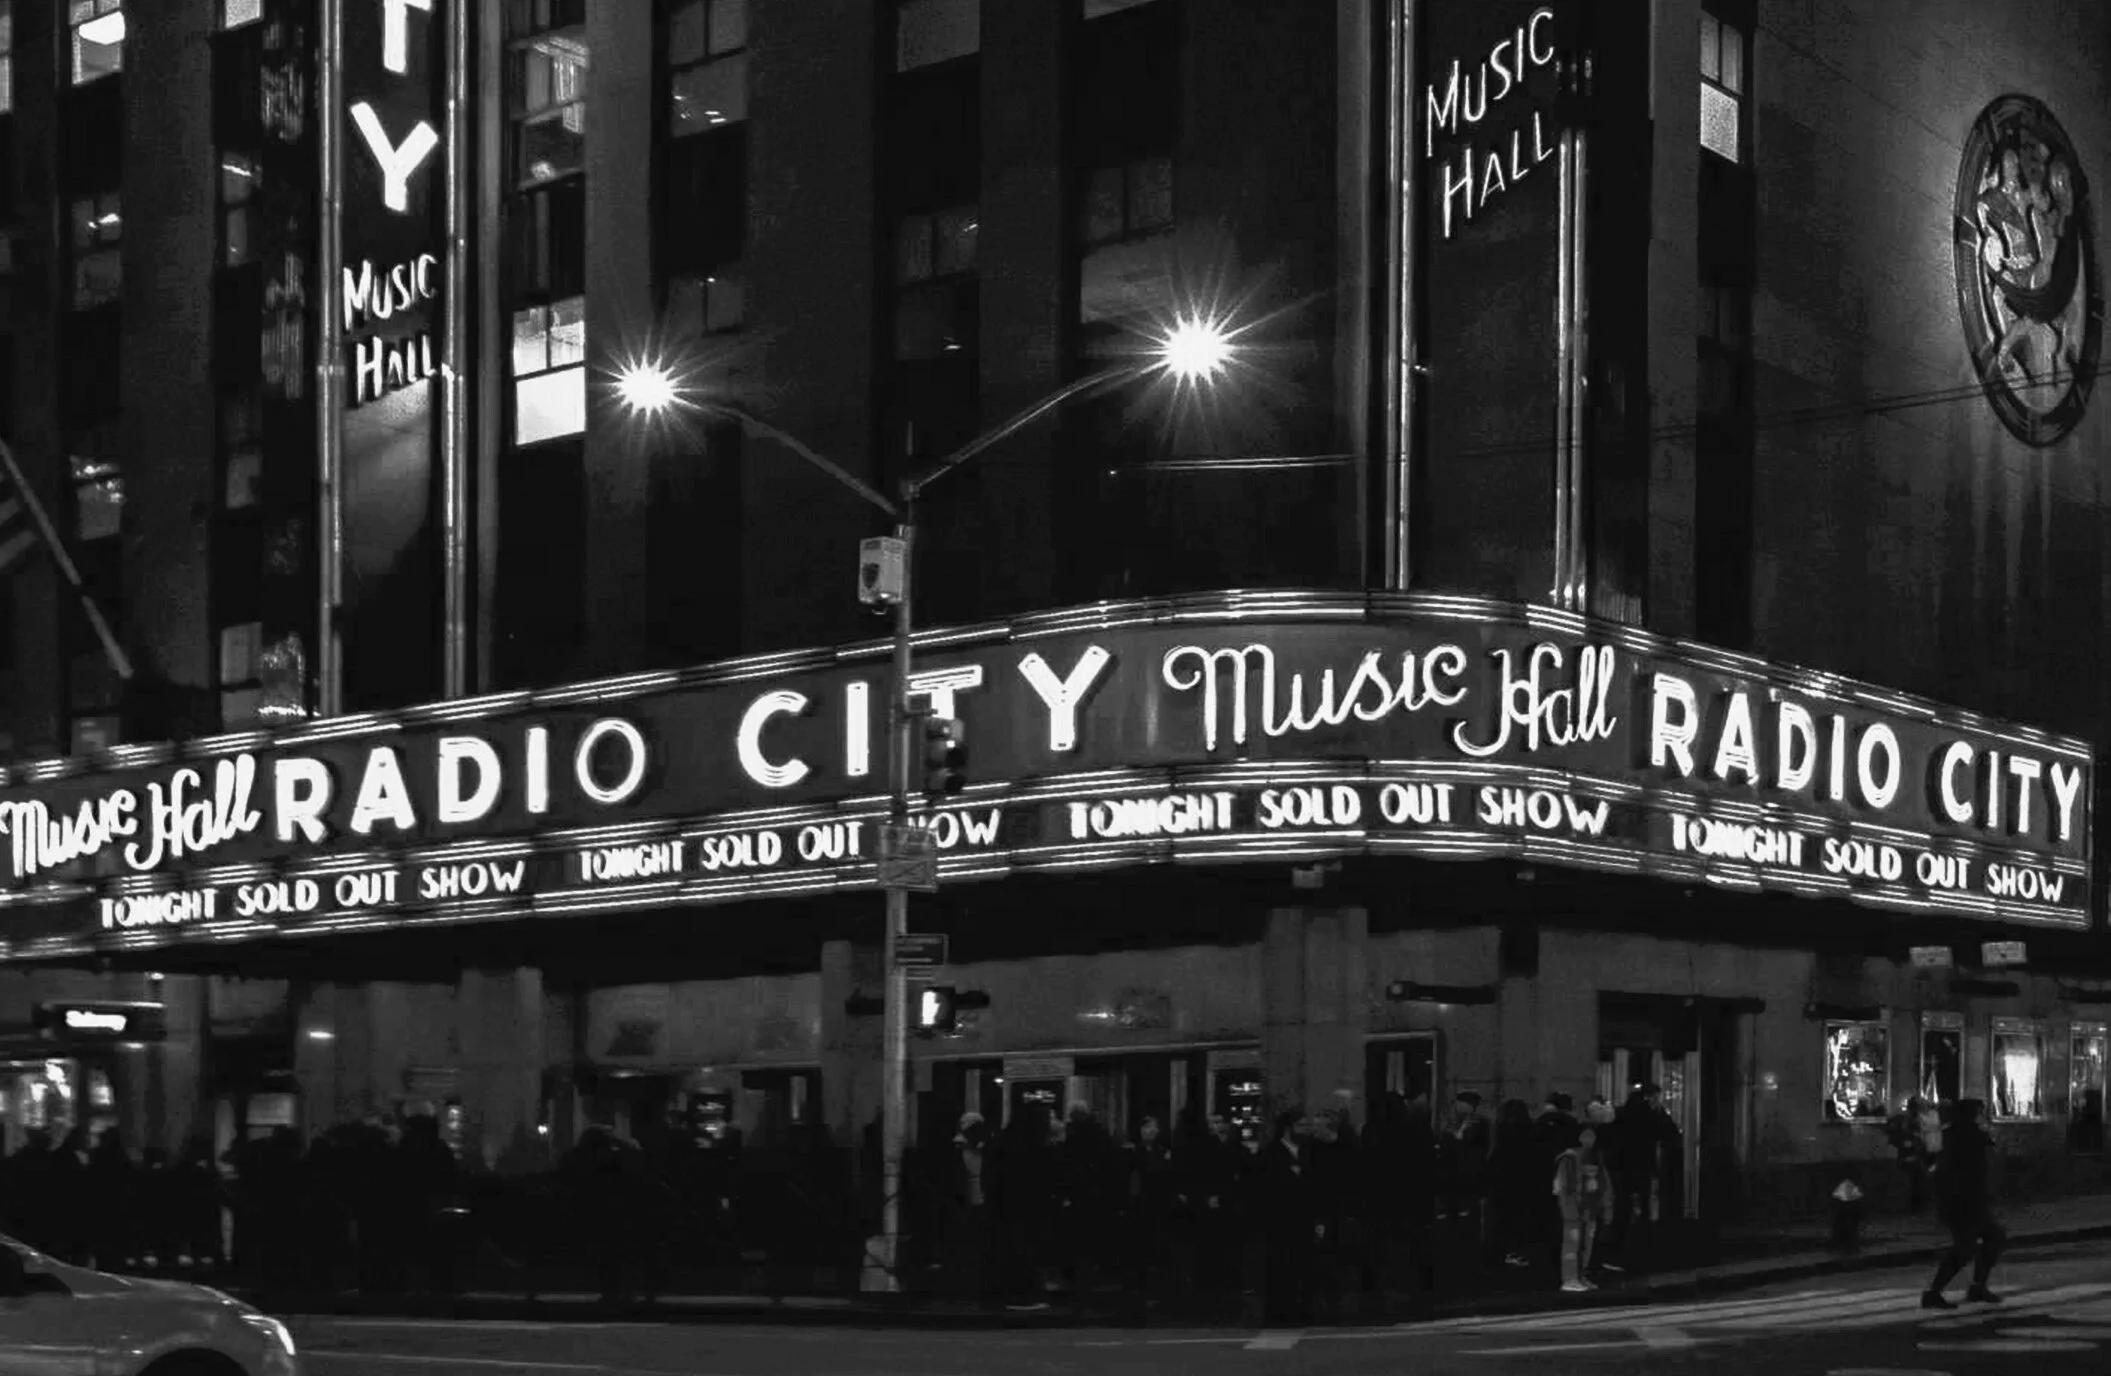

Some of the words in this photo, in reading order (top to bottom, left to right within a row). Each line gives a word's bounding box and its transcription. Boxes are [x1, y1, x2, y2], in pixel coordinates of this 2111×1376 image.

[1427, 11, 1554, 157] MUSIC
[1443, 112, 1553, 238] HALL
[343, 253, 436, 330] MUSIC
[356, 335, 436, 402] HALL
[274, 718, 646, 843] RADIO
[736, 644, 1111, 788] CITY
[1161, 643, 1468, 750] Music
[1453, 642, 1617, 757] Hall
[1651, 672, 1902, 810] RADIO
[1940, 740, 2082, 842] CITY
[0, 788, 138, 878] Music
[124, 753, 262, 871] Hall
[579, 840, 685, 882] TONIGHT
[701, 830, 782, 871] SOLD
[797, 820, 864, 861] OUT
[907, 808, 1000, 849] OW
[1067, 791, 1235, 839] TONIGHT
[1259, 785, 1362, 828] SOLD
[1379, 782, 1455, 824] OUT
[1479, 785, 1610, 835] SHOW
[100, 887, 219, 929] TONIGHT
[235, 878, 320, 917] SOLD
[335, 869, 399, 907] OUT
[419, 860, 525, 899] SHOW
[1672, 813, 1805, 866] TONIGHT
[1822, 837, 1903, 881] SOLD
[1916, 851, 1971, 889] OUT
[1986, 862, 2064, 903] SHOW
